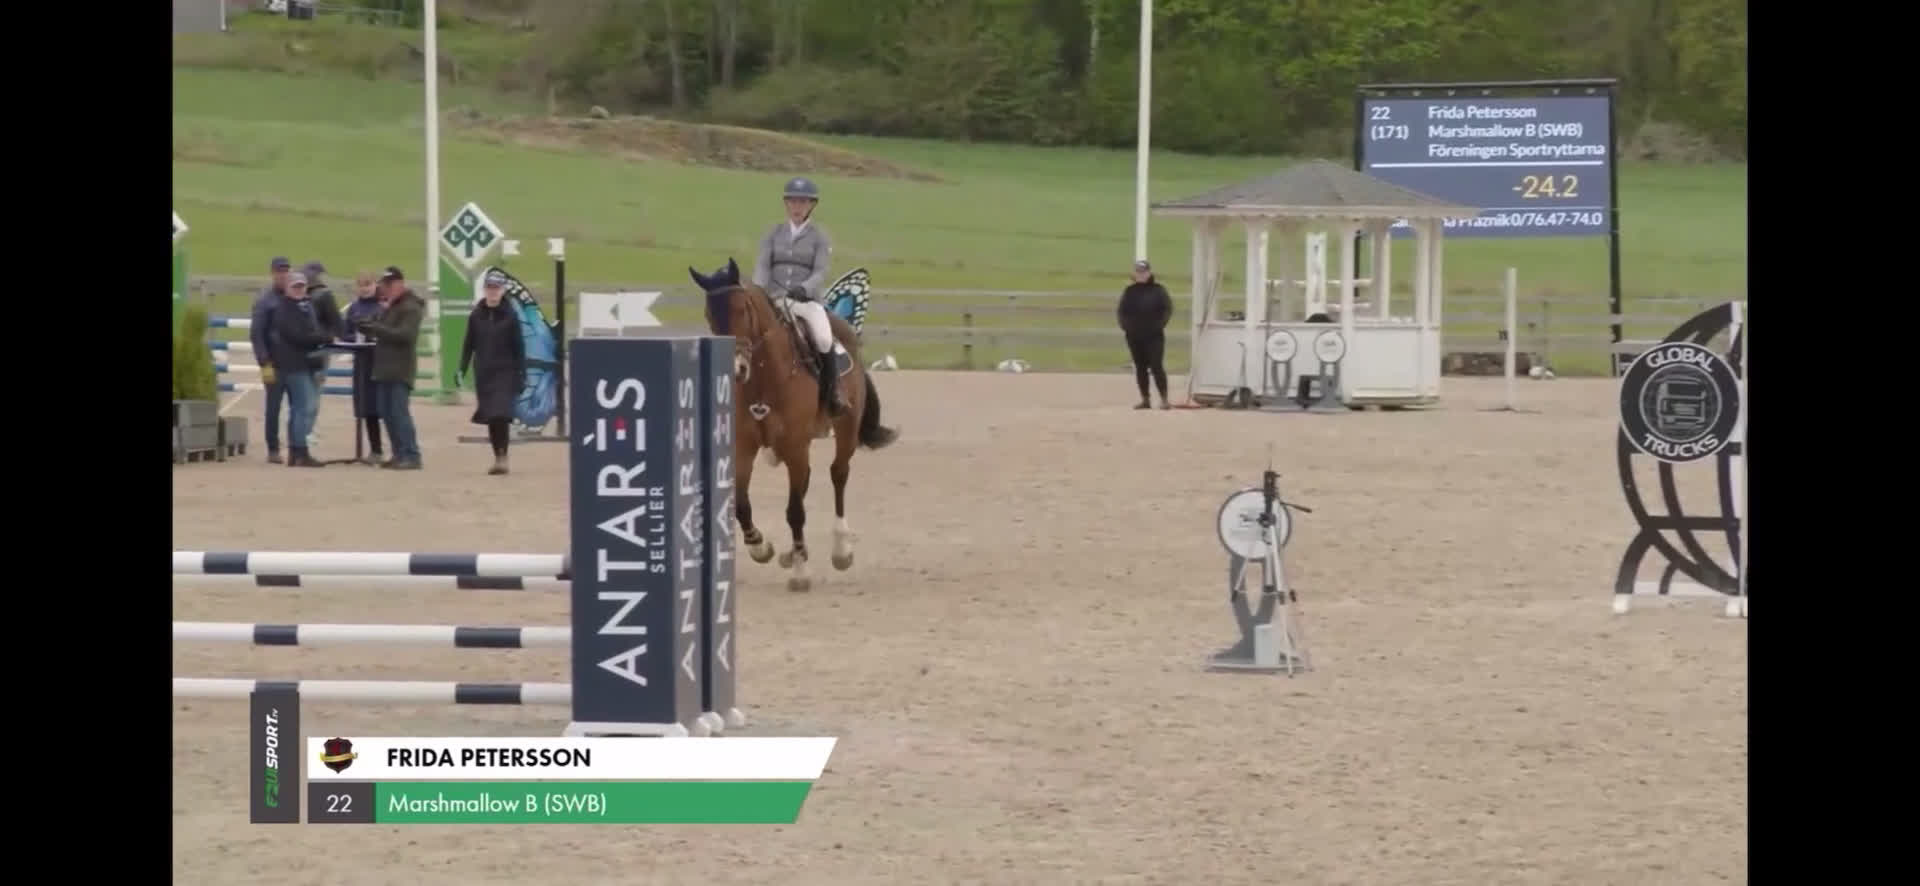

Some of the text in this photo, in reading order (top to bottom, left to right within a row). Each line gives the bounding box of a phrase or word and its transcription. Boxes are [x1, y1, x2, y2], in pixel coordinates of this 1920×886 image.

[1371, 106, 1390, 120] 22
[1428, 105, 1537, 119] Frida Petersson
[1371, 125, 1409, 141] (171)
[1428, 122, 1583, 139] Marshmallow B (SWB)
[1428, 141, 1605, 160] Föreningen Sportryttarna
[1512, 175, 1579, 198] -24.2
[1645, 347, 1714, 373] GLOBAL
[1643, 433, 1719, 458] TRUCKS
[583, 377, 649, 687] ANTARÈS
[649, 485, 666, 574] SELLIER
